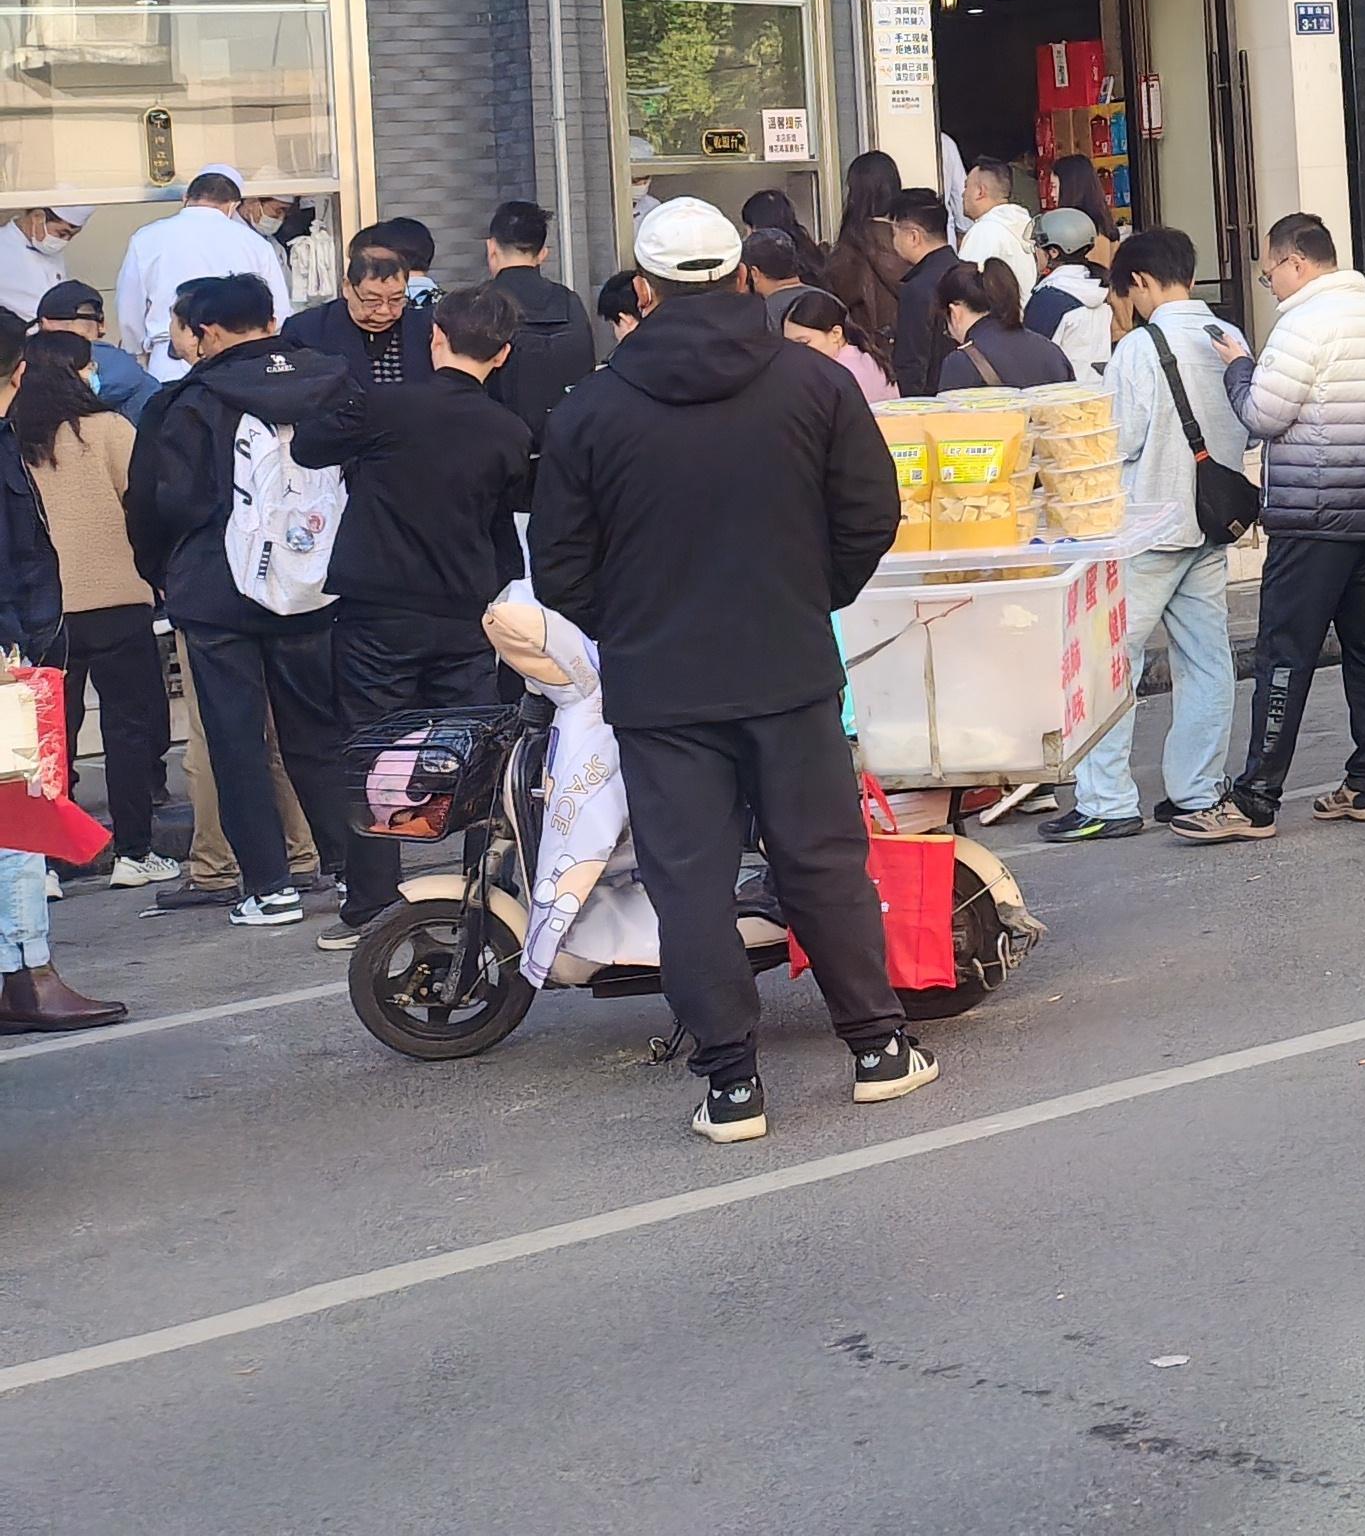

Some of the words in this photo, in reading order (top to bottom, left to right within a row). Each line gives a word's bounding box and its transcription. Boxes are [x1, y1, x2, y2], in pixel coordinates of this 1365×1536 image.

[767, 115, 803, 129] 温馨提示
[266, 364, 296, 373] CAMEL
[550, 754, 610, 836] SPACE
